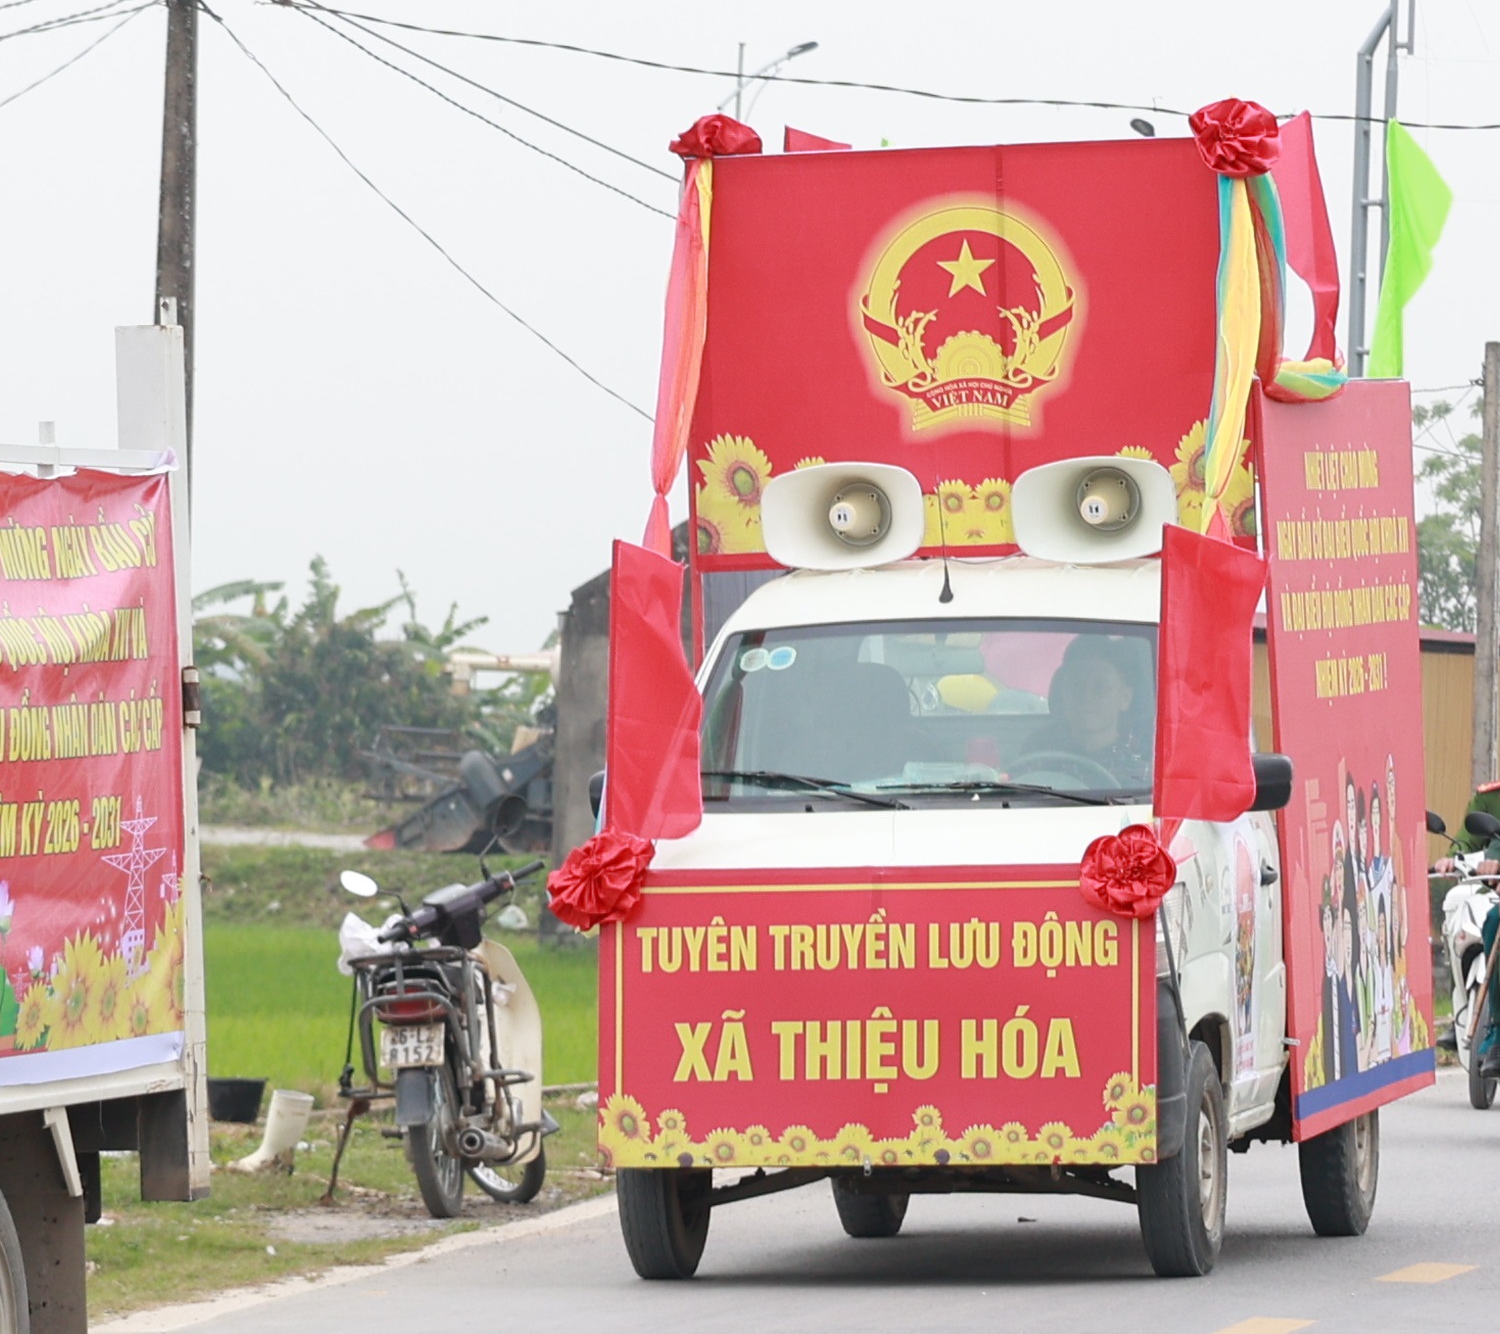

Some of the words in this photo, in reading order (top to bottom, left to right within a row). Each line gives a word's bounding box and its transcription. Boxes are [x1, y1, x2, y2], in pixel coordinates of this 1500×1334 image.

[931, 389, 970, 408] VIỆT
[972, 389, 1009, 407] NAM
[51, 512, 99, 582] NGÀY
[89, 505, 143, 574] BẦU
[128, 501, 158, 570] CỬ
[31, 605, 79, 677] HỘI
[131, 595, 149, 661] VÀ
[1348, 654, 1365, 695] 2026
[7, 687, 53, 765] ĐỒNG
[51, 691, 90, 761] NHÂN
[89, 689, 119, 757] DÂN
[118, 687, 143, 755] CÁC
[141, 677, 164, 753] CẤP
[19, 788, 47, 858] KỲ
[42, 797, 82, 856] 2026
[82, 821, 91, 835] -
[90, 794, 123, 852] 2031
[636, 915, 758, 974] TUYÊN
[768, 907, 917, 972] TRUYỀN
[928, 917, 1001, 970] LƯU
[1011, 910, 1120, 979] ĐỘNG
[672, 1008, 754, 1083] XÃ
[771, 1005, 941, 1094] THIỆU
[960, 1004, 1082, 1080] HÓA
